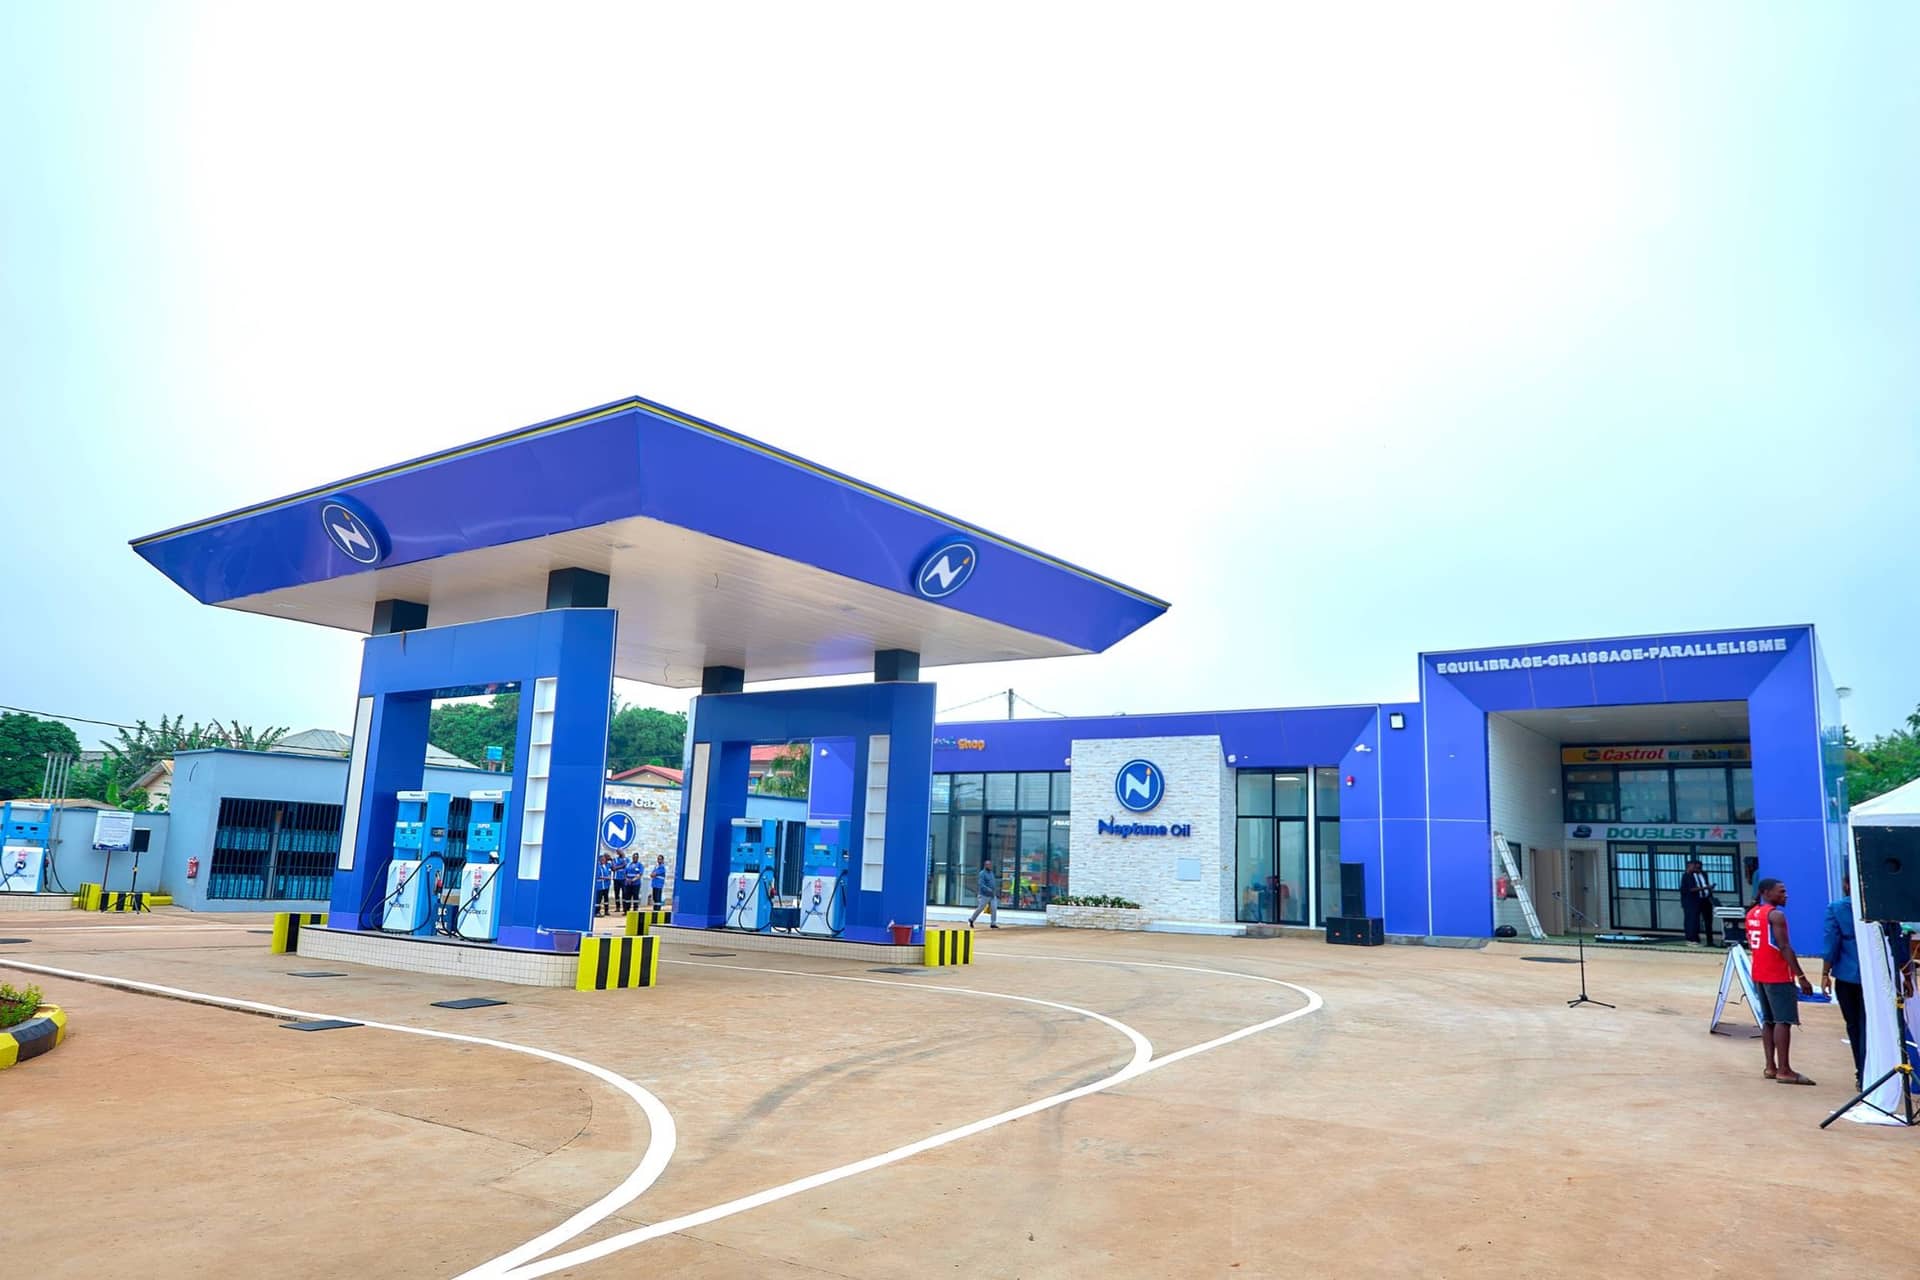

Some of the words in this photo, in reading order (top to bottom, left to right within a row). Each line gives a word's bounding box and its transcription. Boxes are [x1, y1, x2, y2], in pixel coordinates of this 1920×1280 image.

[1437, 638, 1787, 674] EQUILIBRAGE-GRAISSAGE-PARALLELISME
[1602, 748, 1665, 761] Castrol
[1098, 817, 1167, 839] Neptune
[1170, 824, 1191, 837] Oil
